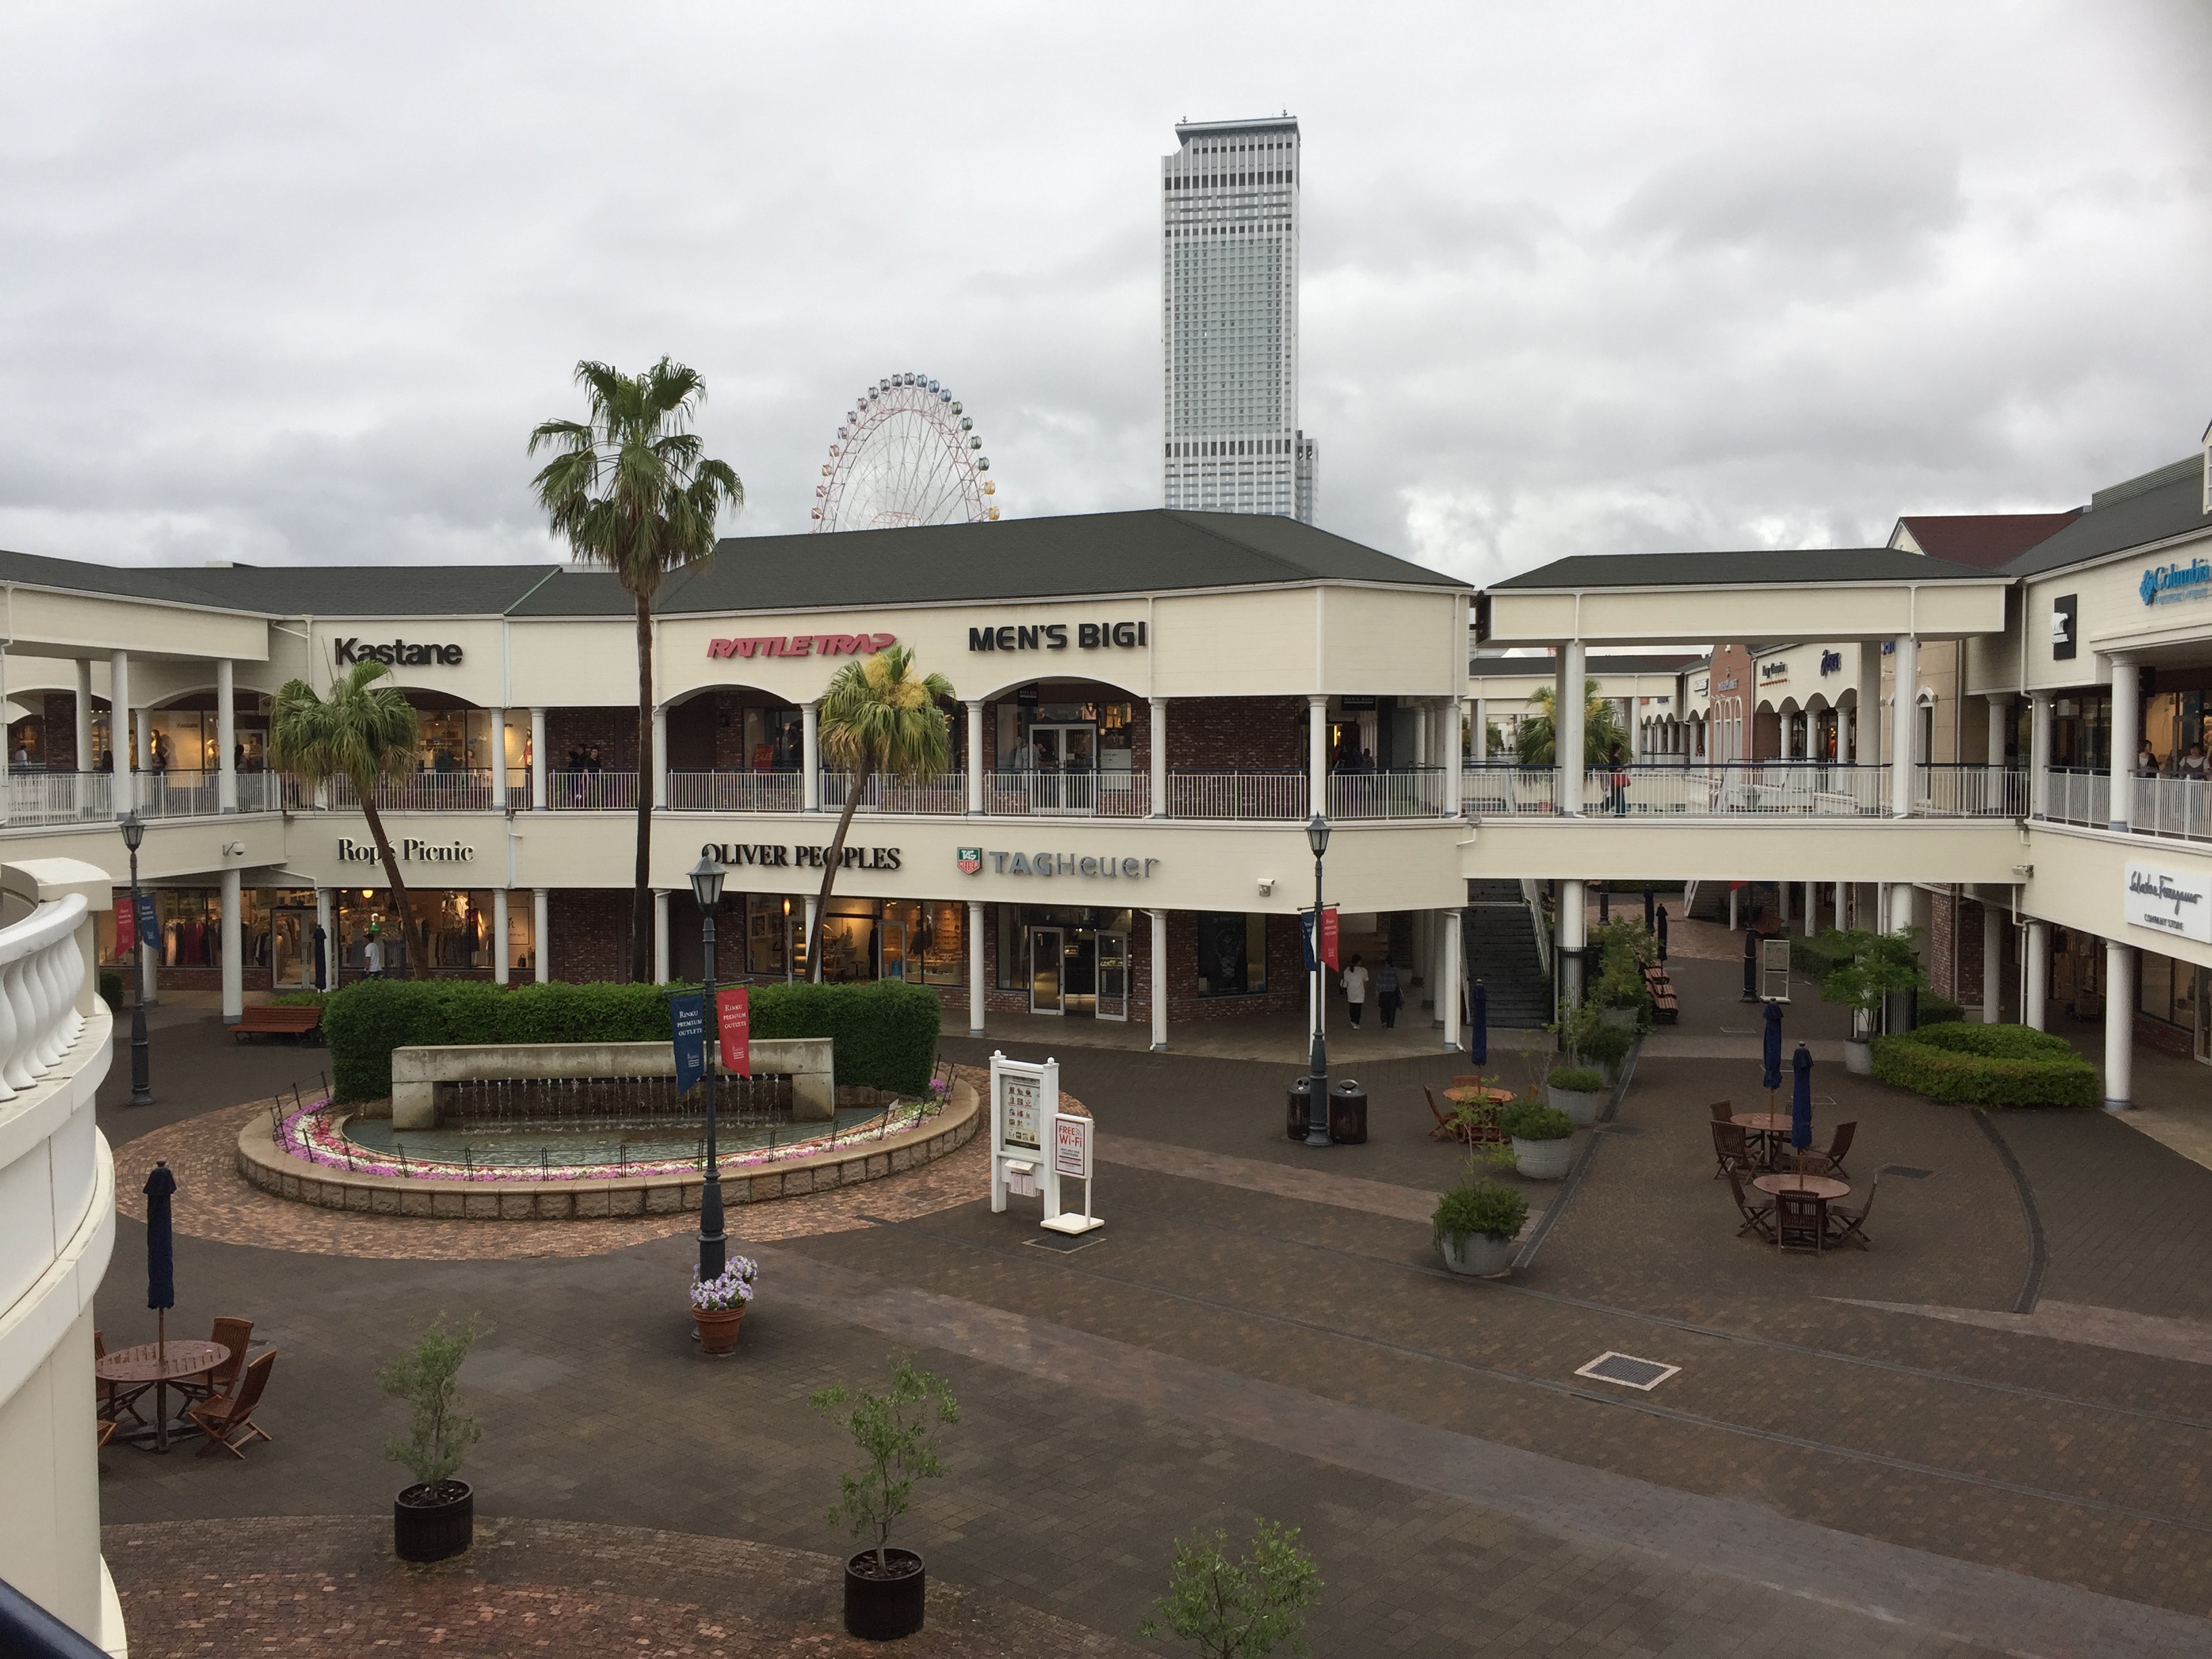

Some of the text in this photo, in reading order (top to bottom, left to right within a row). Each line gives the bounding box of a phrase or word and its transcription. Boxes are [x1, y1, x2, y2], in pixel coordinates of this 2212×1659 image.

[2154, 558, 2209, 591] Columbia
[969, 621, 1147, 651] MEN'S BIGI
[335, 638, 464, 665] Kastane
[707, 633, 896, 658] RATTLETRAP
[402, 838, 474, 861] Picnic
[701, 843, 790, 867] OLIVER
[961, 850, 977, 860] TAG
[959, 861, 979, 872] HEUER
[723, 1012, 746, 1021] PREMIUM
[677, 1019, 702, 1028] PREMIUM
[724, 1021, 747, 1029] OUTLETS
[678, 1027, 702, 1036] OUTLETS
[1059, 1125, 1076, 1136] FREE
[1059, 1134, 1082, 1148] Wi-Fi
